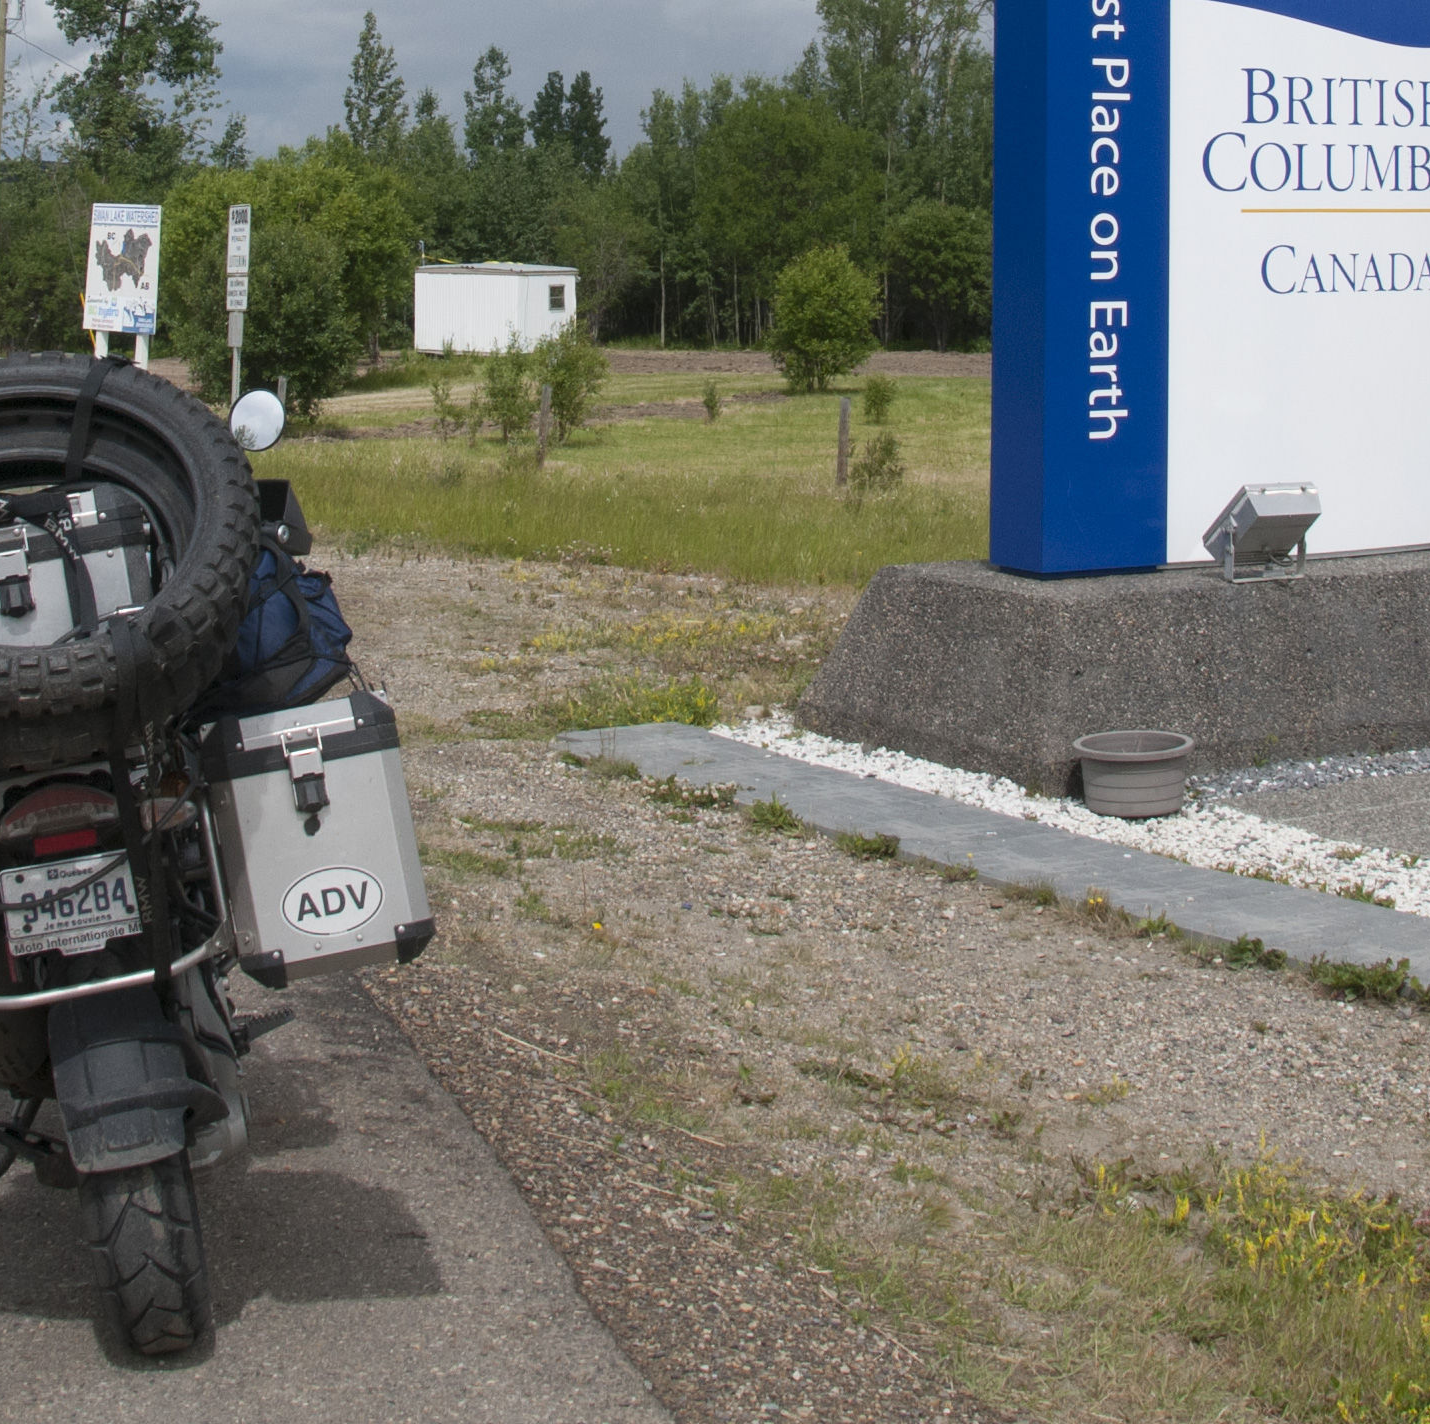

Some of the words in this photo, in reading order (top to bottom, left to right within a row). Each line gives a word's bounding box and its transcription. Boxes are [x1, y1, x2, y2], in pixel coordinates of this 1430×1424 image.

[1090, 58, 1131, 196] Place
[94, 209, 110, 221] SWAN
[110, 210, 125, 222] LAKE
[126, 210, 159, 223] WATERSHED
[107, 232, 116, 240] BC
[1090, 212, 1119, 280] on
[140, 282, 150, 290] AB
[1088, 300, 1128, 440] Earth
[21, 876, 129, 924] 946284
[134, 876, 153, 924] BMW
[297, 880, 368, 922] ADV
[14, 940, 44, 955] Moto
[47, 926, 125, 949] Internationale
[44, 922, 53, 931] Je
[56, 920, 70, 929] me
[72, 914, 112, 926] souviens
